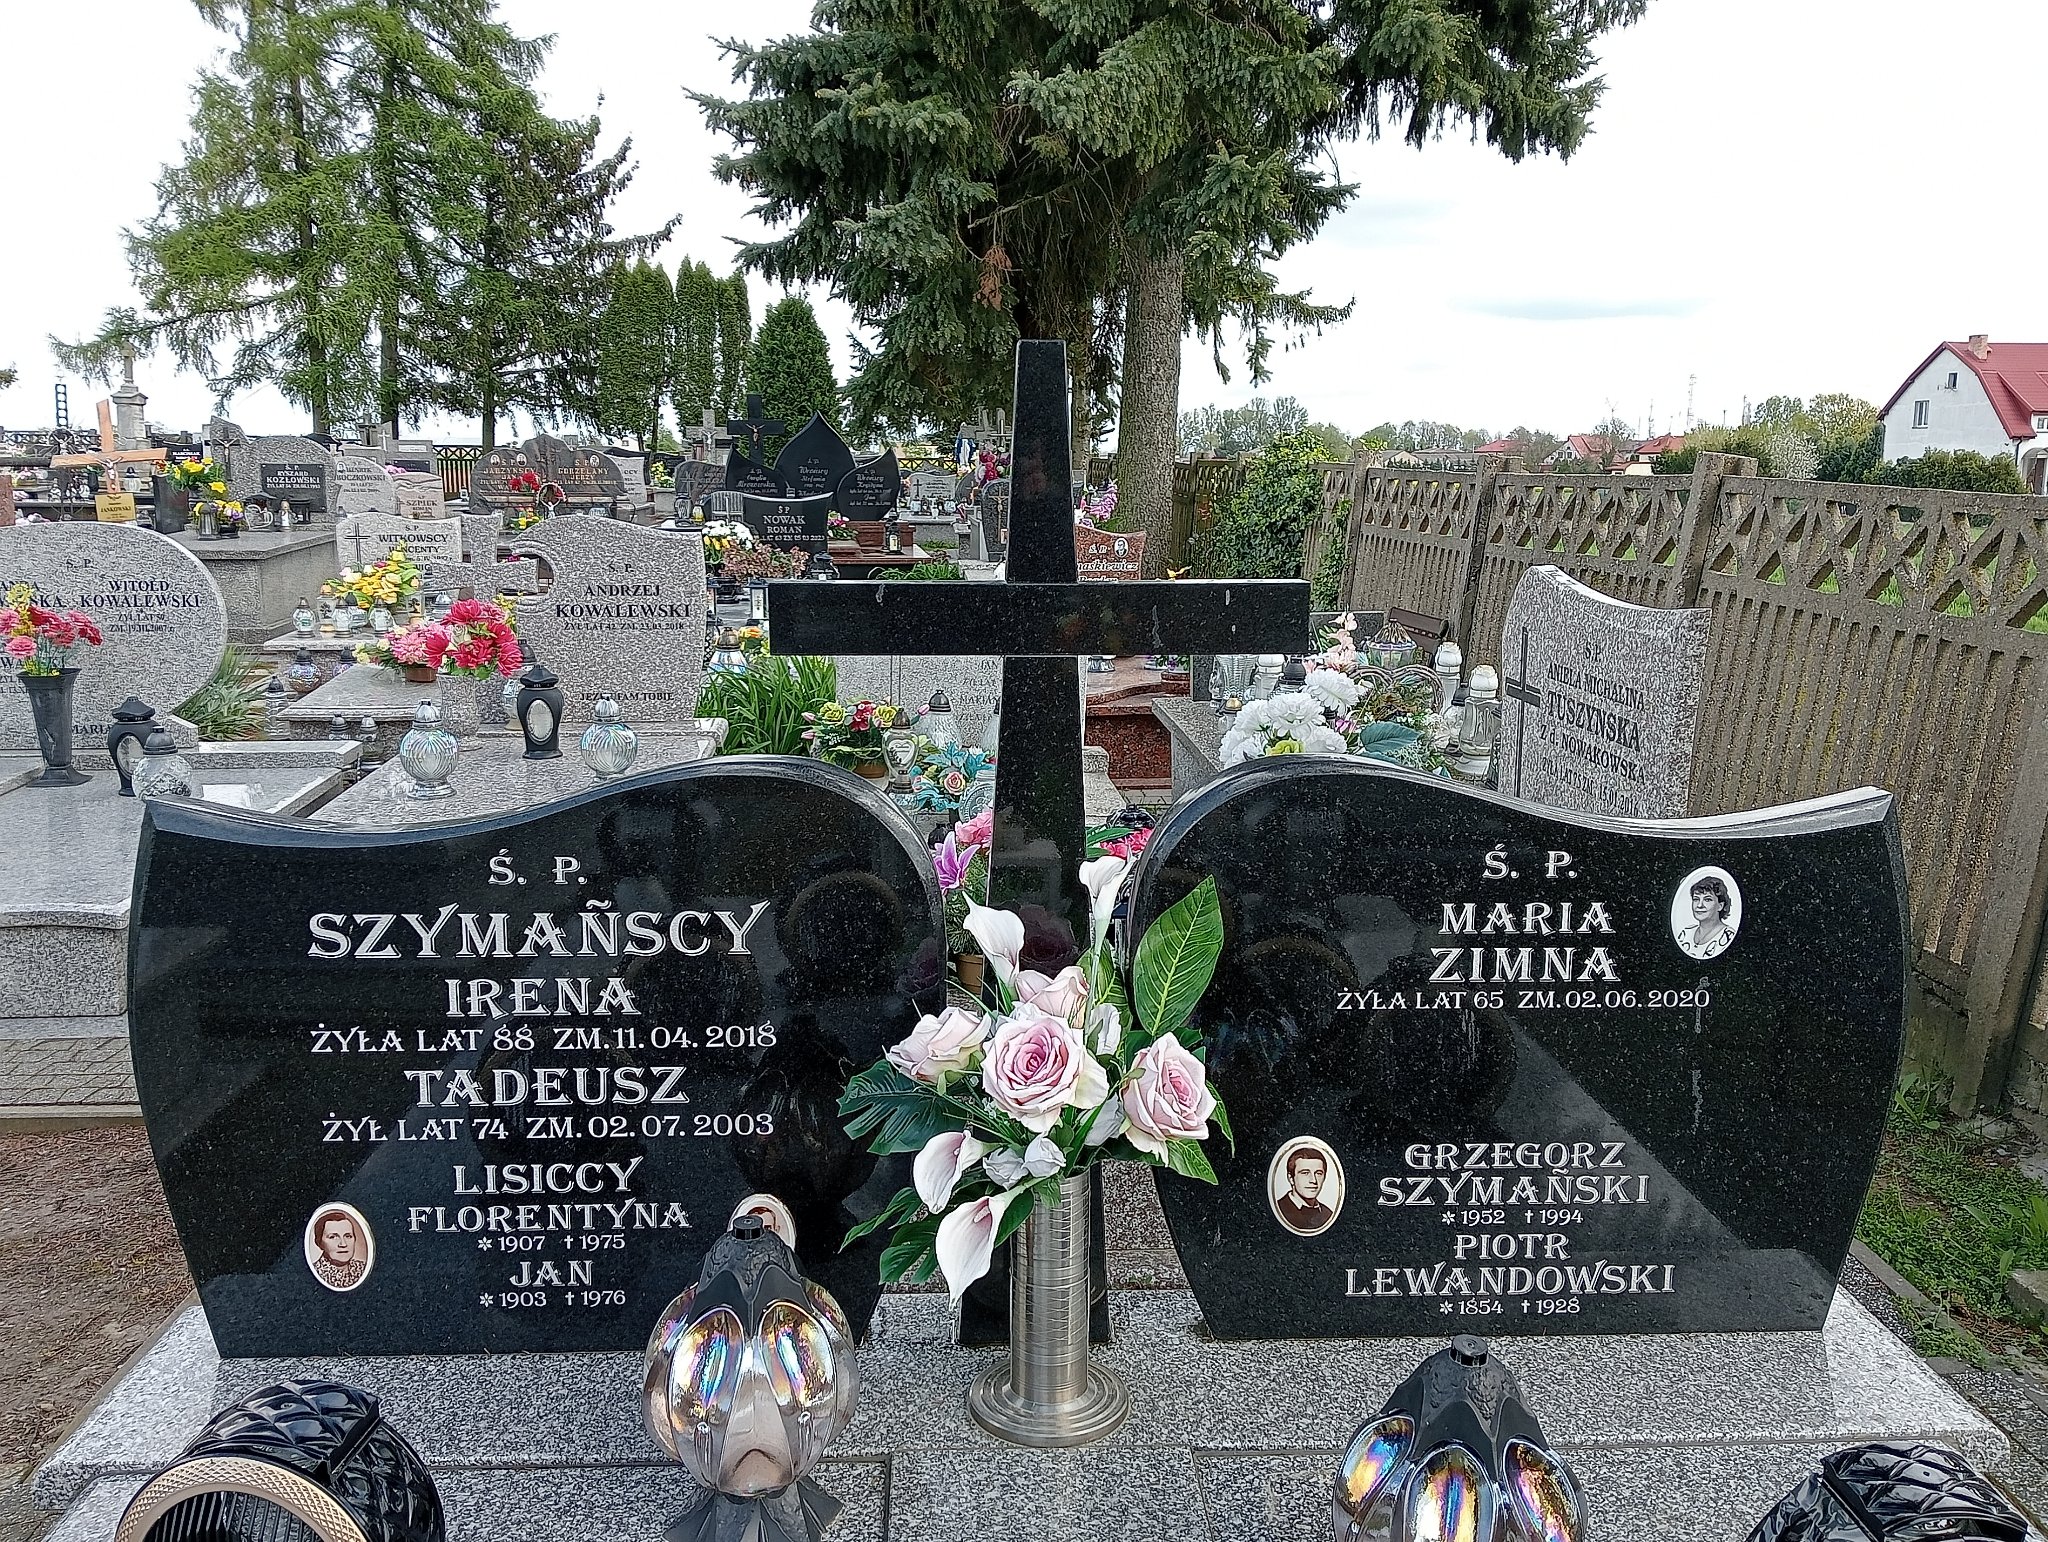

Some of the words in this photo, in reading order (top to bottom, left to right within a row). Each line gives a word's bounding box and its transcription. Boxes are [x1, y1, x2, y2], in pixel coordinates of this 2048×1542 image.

[266, 476, 321, 484] KOZŁOWSKI
[762, 515, 806, 525] NOWAK
[767, 526, 803, 534] ROMAN
[378, 533, 449, 543] WITKOWSCY
[80, 594, 201, 608] KOWALEWSKI
[583, 584, 661, 597] ANDRZEJ
[556, 603, 692, 618] KOWALEWSKI
[1561, 732, 1646, 786] NOWAKOWSKA
[488, 848, 527, 886] Ś.
[552, 856, 588, 886] P.
[1482, 844, 1520, 880] Ś.
[1545, 850, 1578, 880] P.
[1437, 902, 1617, 937] MARIA
[1428, 946, 1622, 983] ZIMNA
[444, 976, 642, 1020] IRENA
[1336, 986, 1408, 1010] ŻYŁA
[1415, 991, 1467, 1010] LAT
[1473, 989, 1504, 1010] 65
[309, 1021, 405, 1053] ŻYŁA
[416, 1029, 484, 1052] LAT
[493, 1023, 535, 1051] 88
[403, 1066, 690, 1108] TADEUSZ
[321, 1112, 389, 1142] ŻYŁ
[397, 1118, 465, 1141] LAT
[471, 1117, 510, 1141] 74
[1404, 1142, 1627, 1172] GRZEGORZ
[452, 1155, 644, 1195] LISICCY
[407, 1197, 692, 1234] FLORENTYNA
[1453, 1233, 1572, 1261] PIOTR
[509, 1260, 594, 1289] JAN
[1344, 1259, 1676, 1297] LEWANDOWSKI
